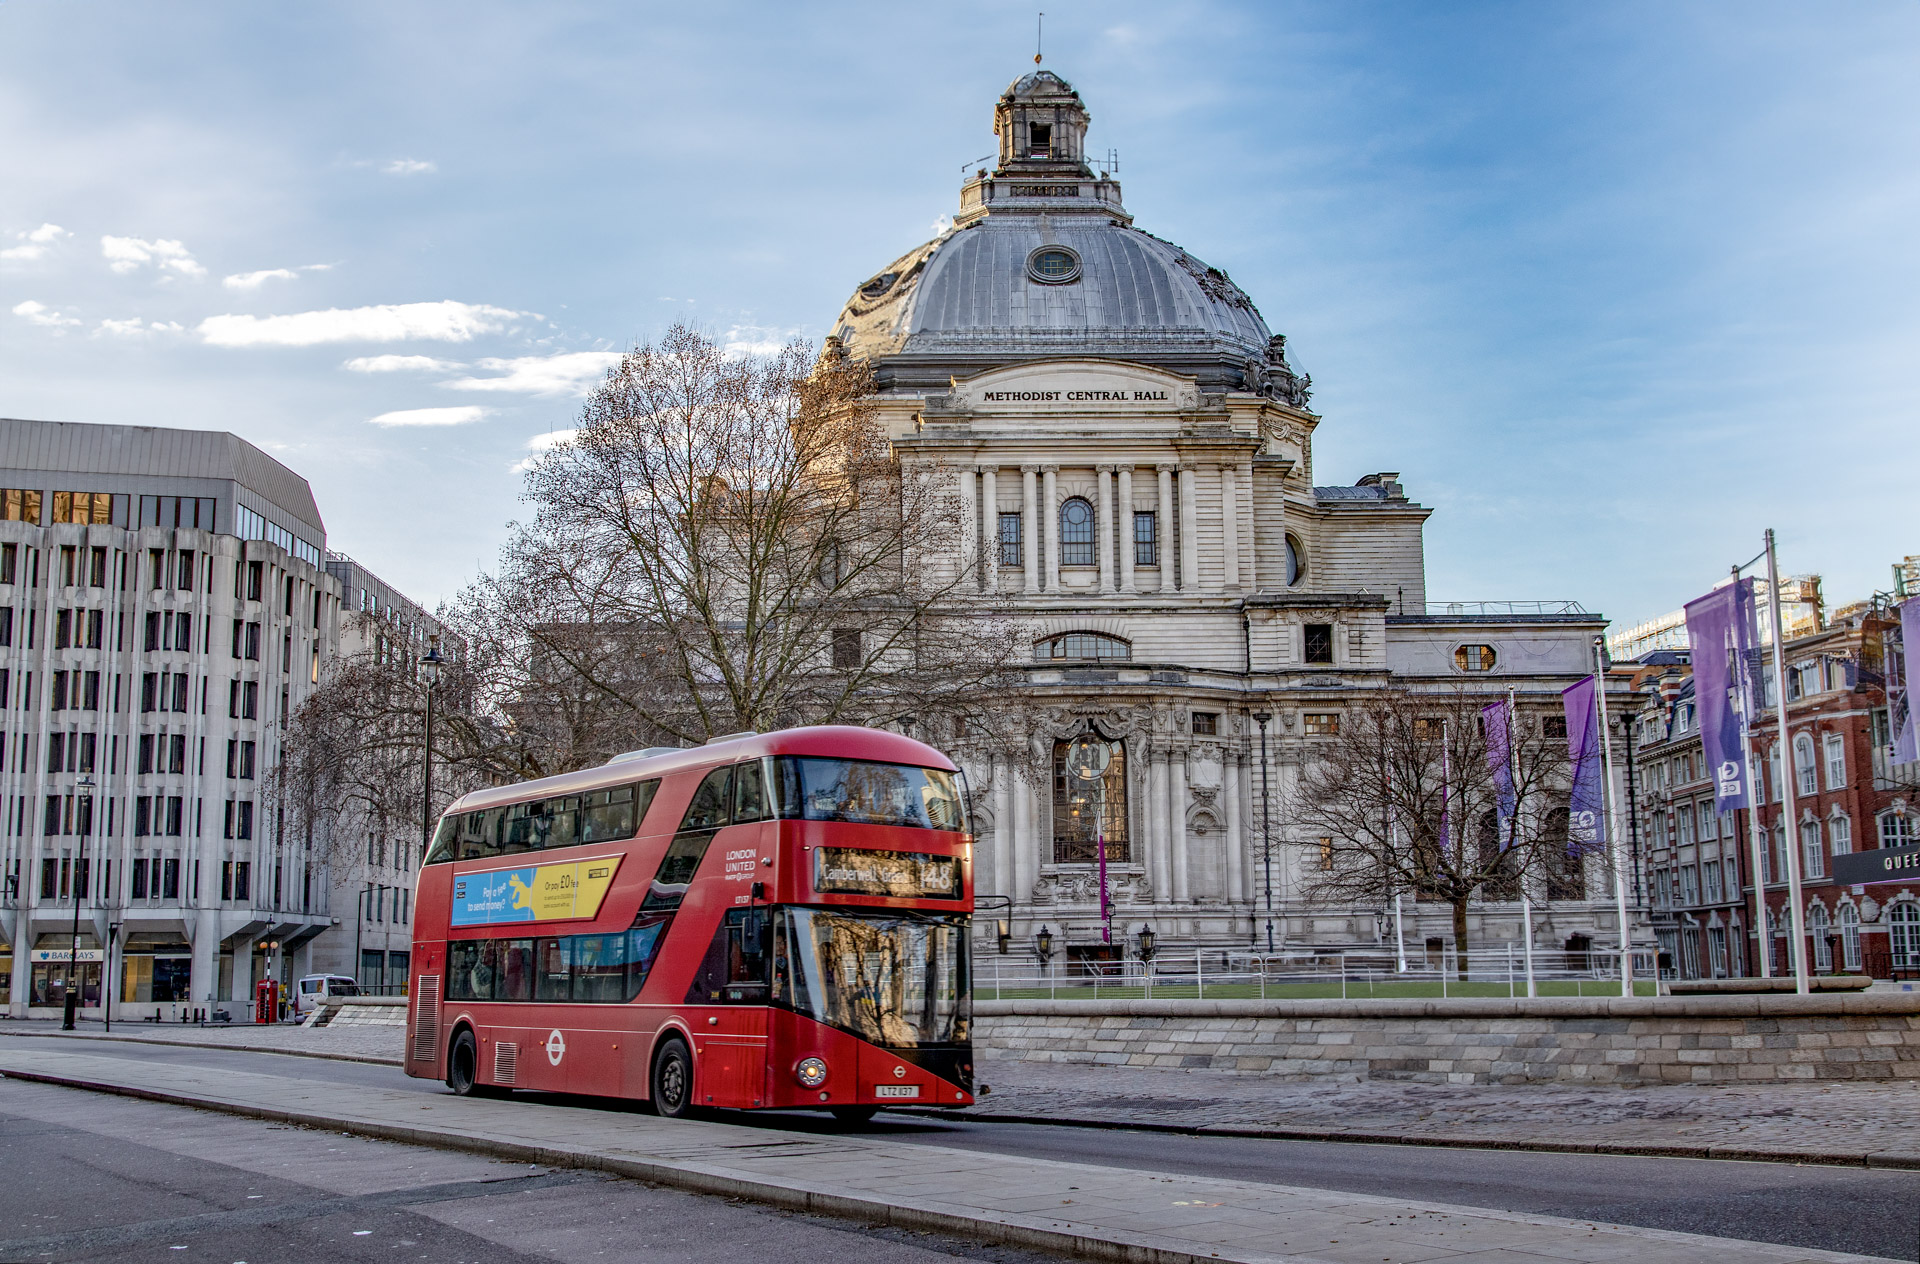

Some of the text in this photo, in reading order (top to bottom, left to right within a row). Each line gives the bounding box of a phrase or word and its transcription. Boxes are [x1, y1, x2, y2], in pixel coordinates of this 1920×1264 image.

[983, 391, 1168, 402] METHODIST CENTRAL HALL
[726, 848, 757, 861] LONDON
[725, 861, 756, 873] UNITED
[551, 881, 560, 891] pay
[560, 874, 571, 889] £0
[823, 864, 879, 882] Camberwell
[920, 864, 951, 890] 148
[483, 887, 493, 899] Pay
[467, 898, 506, 912] to send money?
[882, 1087, 897, 1095] LTZ
